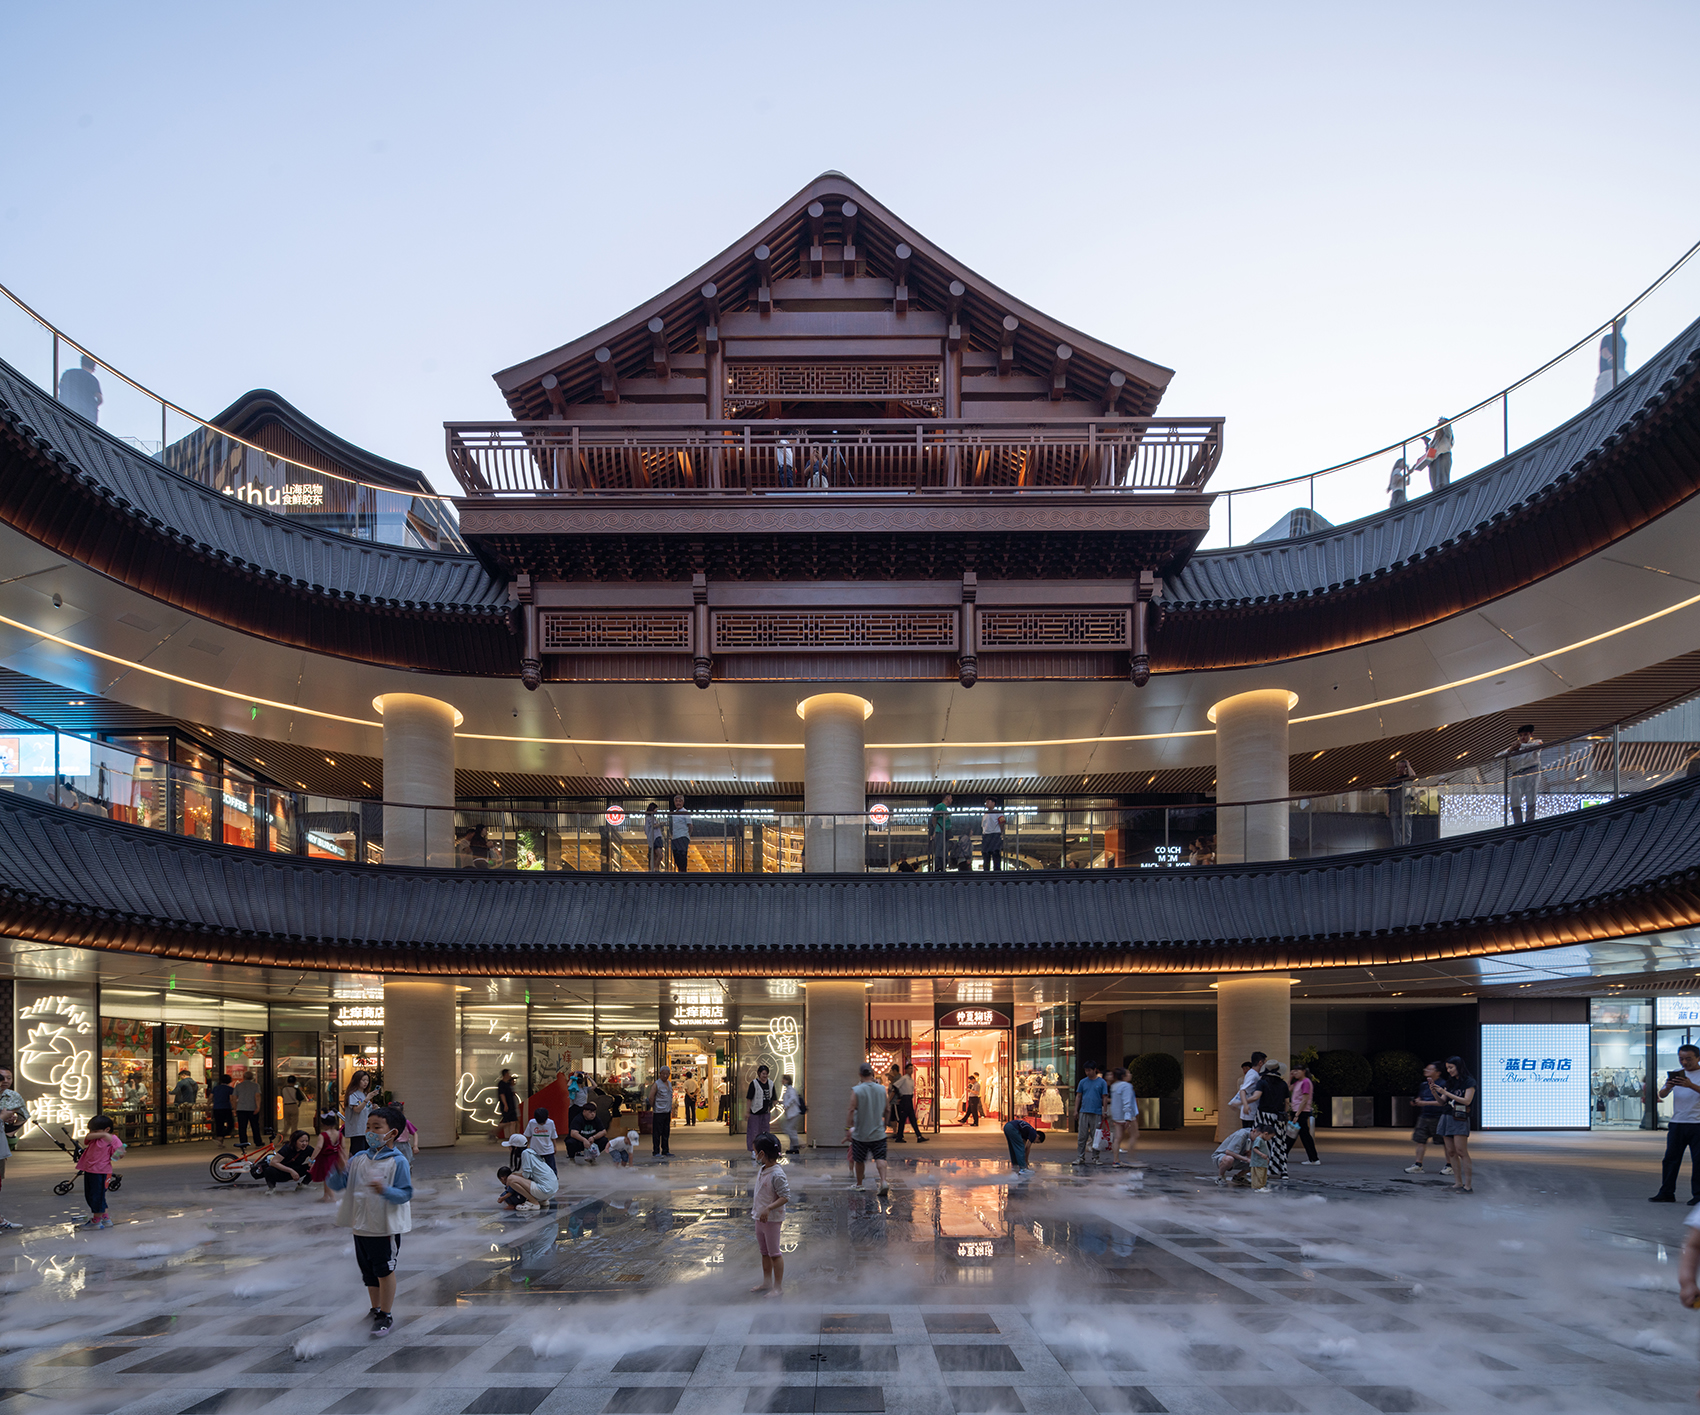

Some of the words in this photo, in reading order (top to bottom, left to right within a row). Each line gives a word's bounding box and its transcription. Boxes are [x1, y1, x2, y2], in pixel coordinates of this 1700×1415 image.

[282, 484, 323, 494] 山海风物
[282, 494, 323, 505] 食鲜胶东
[19, 995, 91, 1034] ZHIYANG
[338, 1006, 385, 1019] 止痒商店
[674, 1005, 724, 1018] 止痒商店
[956, 1010, 994, 1022] 仲夏物语
[1678, 1011, 1699, 1020] 蓝白
[776, 1033, 796, 1053] 痒
[1504, 1058, 1537, 1071] 蓝白
[1541, 1058, 1573, 1071] 商店
[1502, 1071, 1527, 1083] Blue
[1530, 1071, 1570, 1083] Weekend
[19, 1094, 92, 1139] 止痒商店
